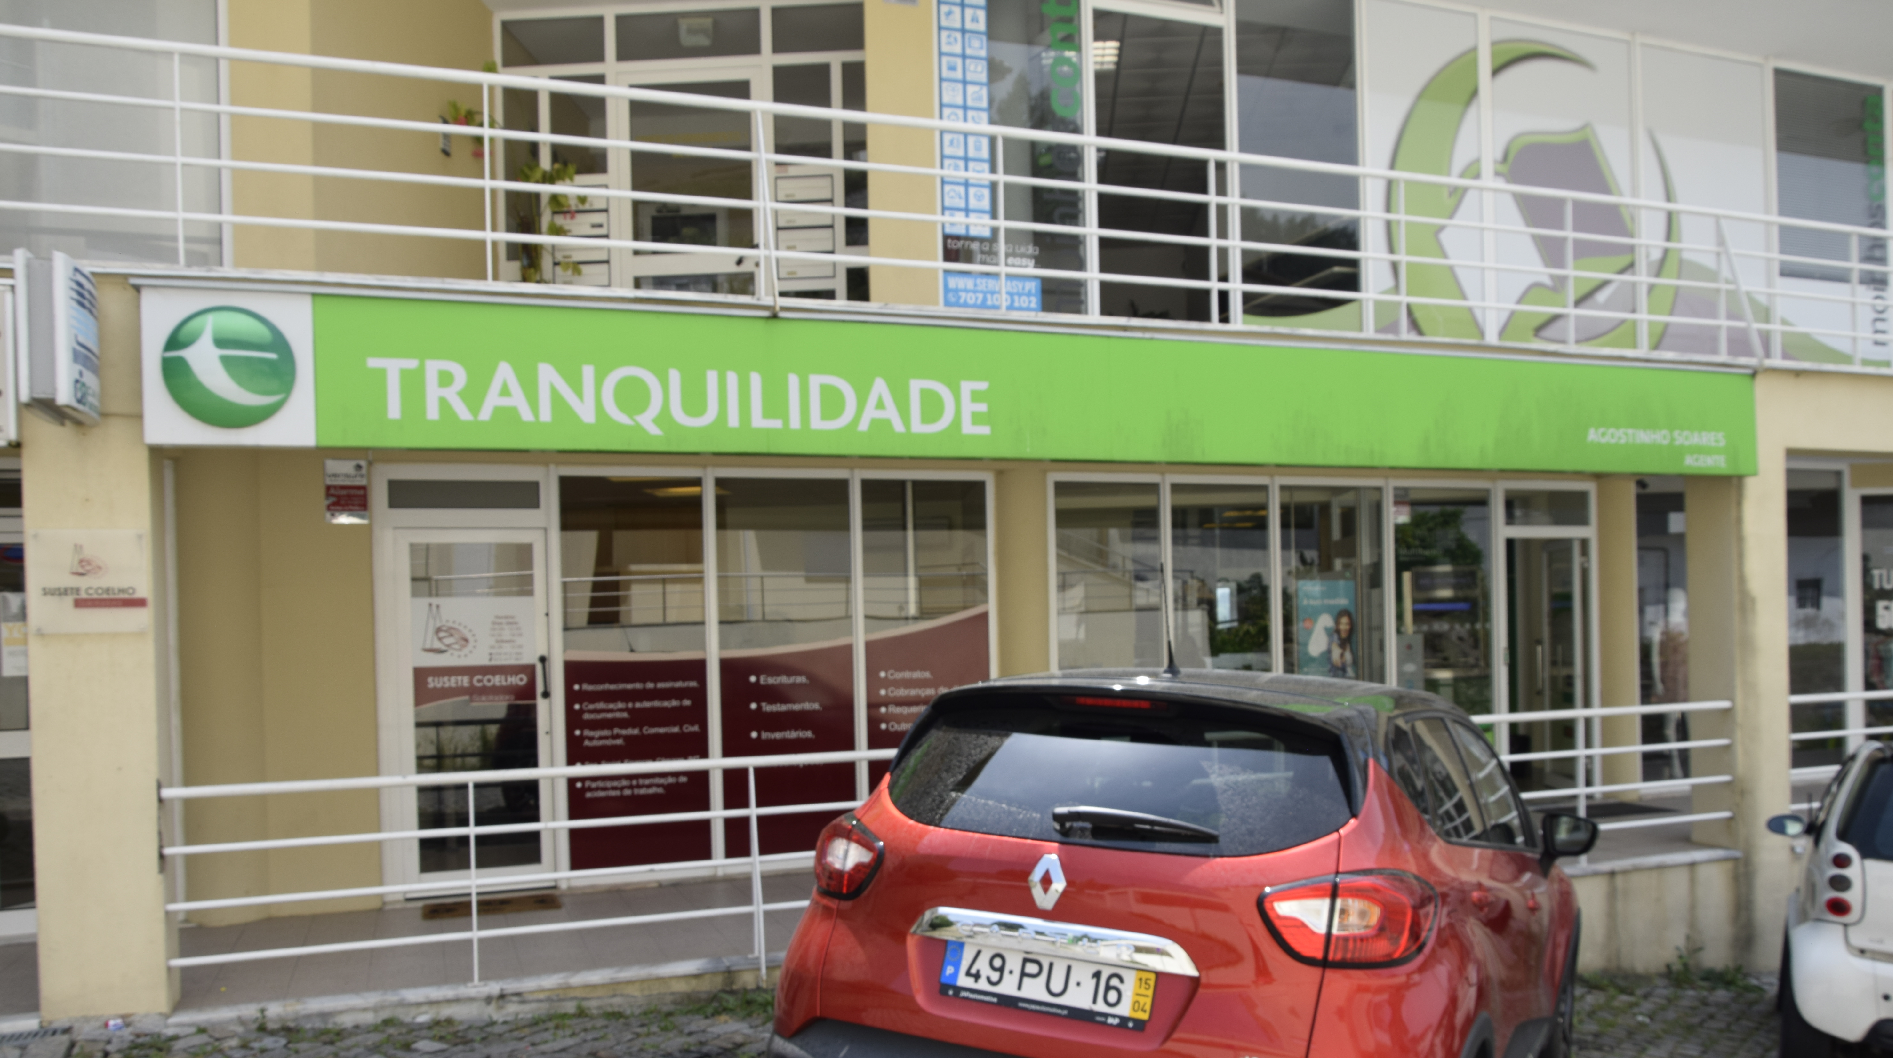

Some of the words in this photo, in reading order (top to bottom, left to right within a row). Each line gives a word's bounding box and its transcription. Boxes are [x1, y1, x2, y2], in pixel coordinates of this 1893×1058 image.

[947, 238, 980, 250] torne
[958, 291, 984, 304] 707
[1013, 295, 1038, 308] 102
[366, 356, 991, 436] TRANQUILIDADE
[1587, 427, 1671, 445] AGOSTINHO
[1673, 430, 1726, 447] SOARES
[1684, 454, 1726, 468] AGENTE
[41, 587, 81, 597] SUSETE
[84, 586, 137, 597] COELHO
[427, 675, 470, 689] SUSETE
[472, 673, 528, 687] COELHO
[645, 680, 655, 690] de
[887, 686, 936, 698] Cobranças
[582, 700, 627, 711] Certificação
[681, 698, 692, 707] de
[582, 728, 612, 739] Registo
[945, 965, 955, 976] P
[1137, 976, 1152, 990] 15
[1132, 1000, 1148, 1014] 04
